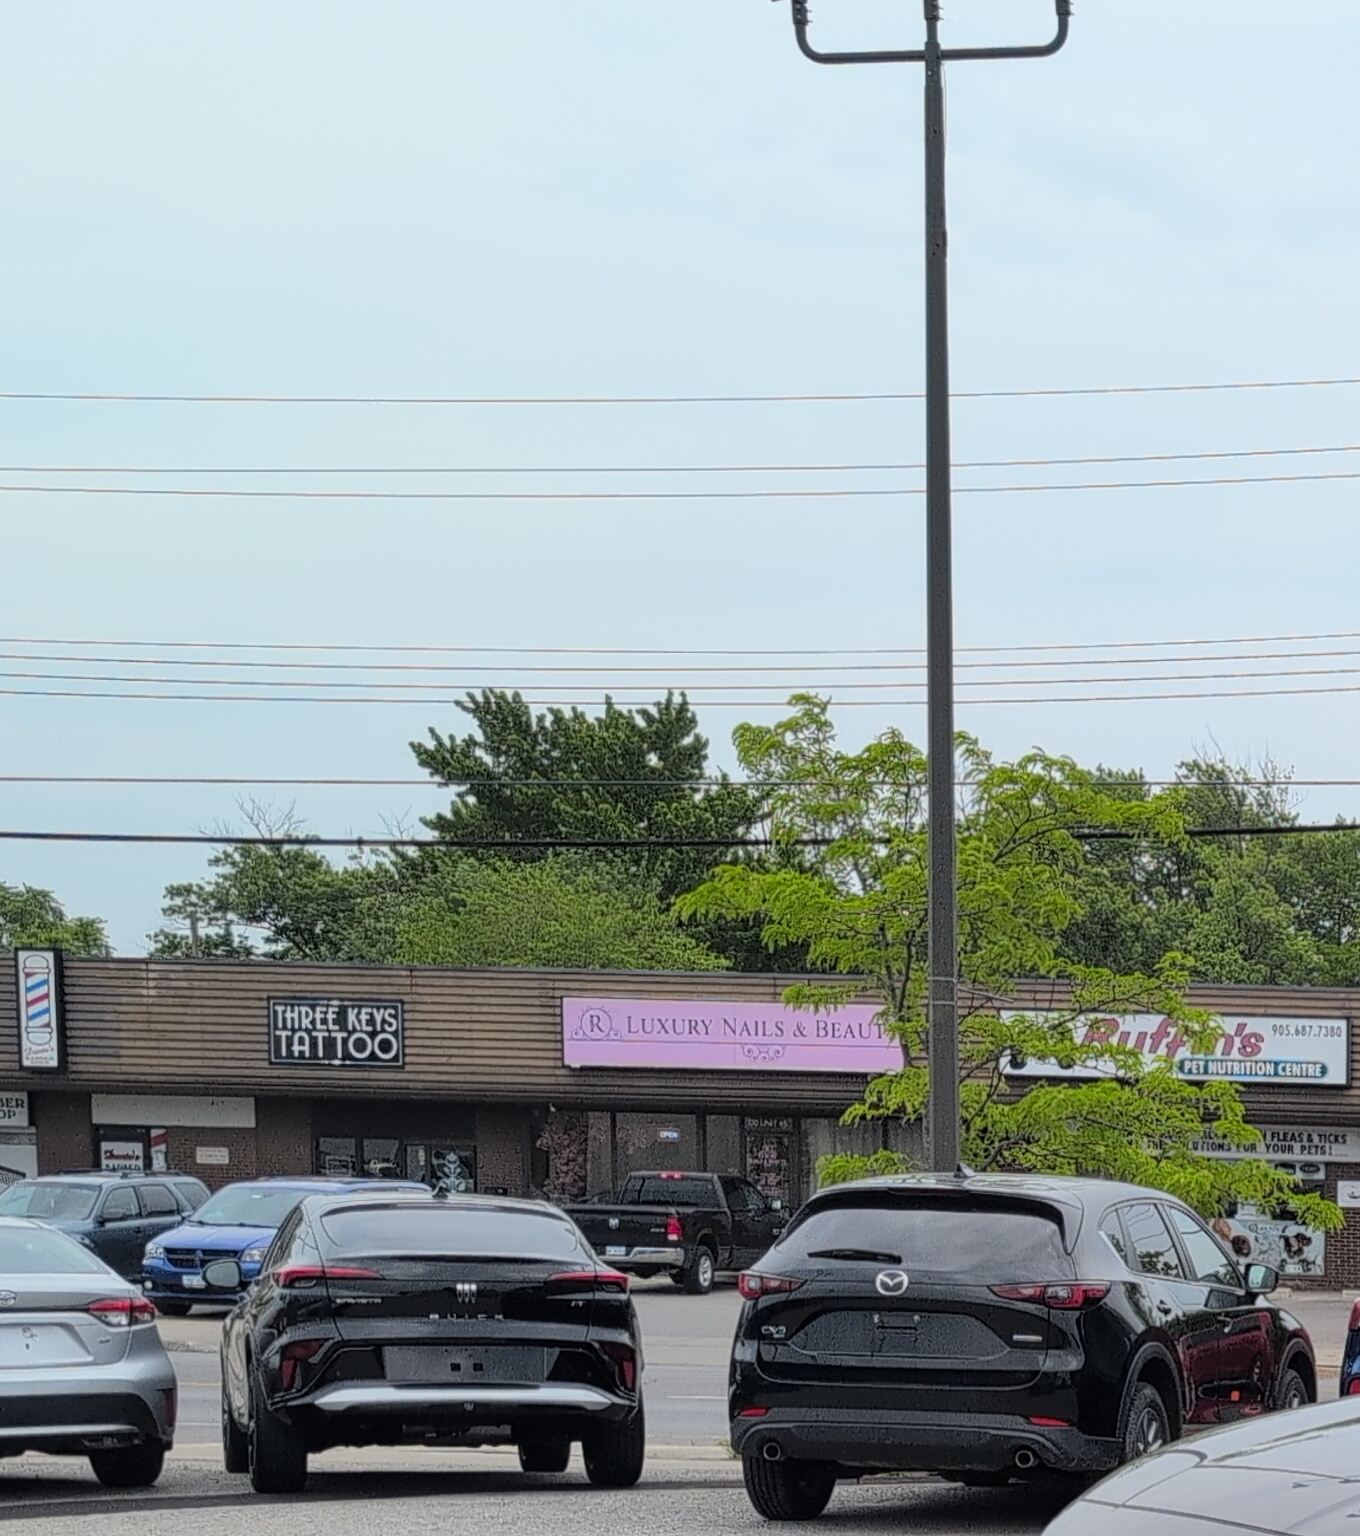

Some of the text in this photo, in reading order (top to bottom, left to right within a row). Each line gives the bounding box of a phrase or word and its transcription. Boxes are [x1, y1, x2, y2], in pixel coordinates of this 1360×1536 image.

[274, 1005, 397, 1032] THREE KEYS
[626, 1015, 887, 1040] LUXURY NAILS & BEAUT
[1271, 1024, 1342, 1038] 905.687.7380
[274, 1030, 398, 1059] TATTOO
[1184, 1061, 1323, 1078] PET NUTRITION CENTRE
[1271, 1132, 1304, 1143] FLEAS
[1306, 1133, 1314, 1144] &
[1317, 1133, 1348, 1145] TICKS
[1265, 1142, 1295, 1155] YOUR
[1300, 1144, 1333, 1157] PETS!
